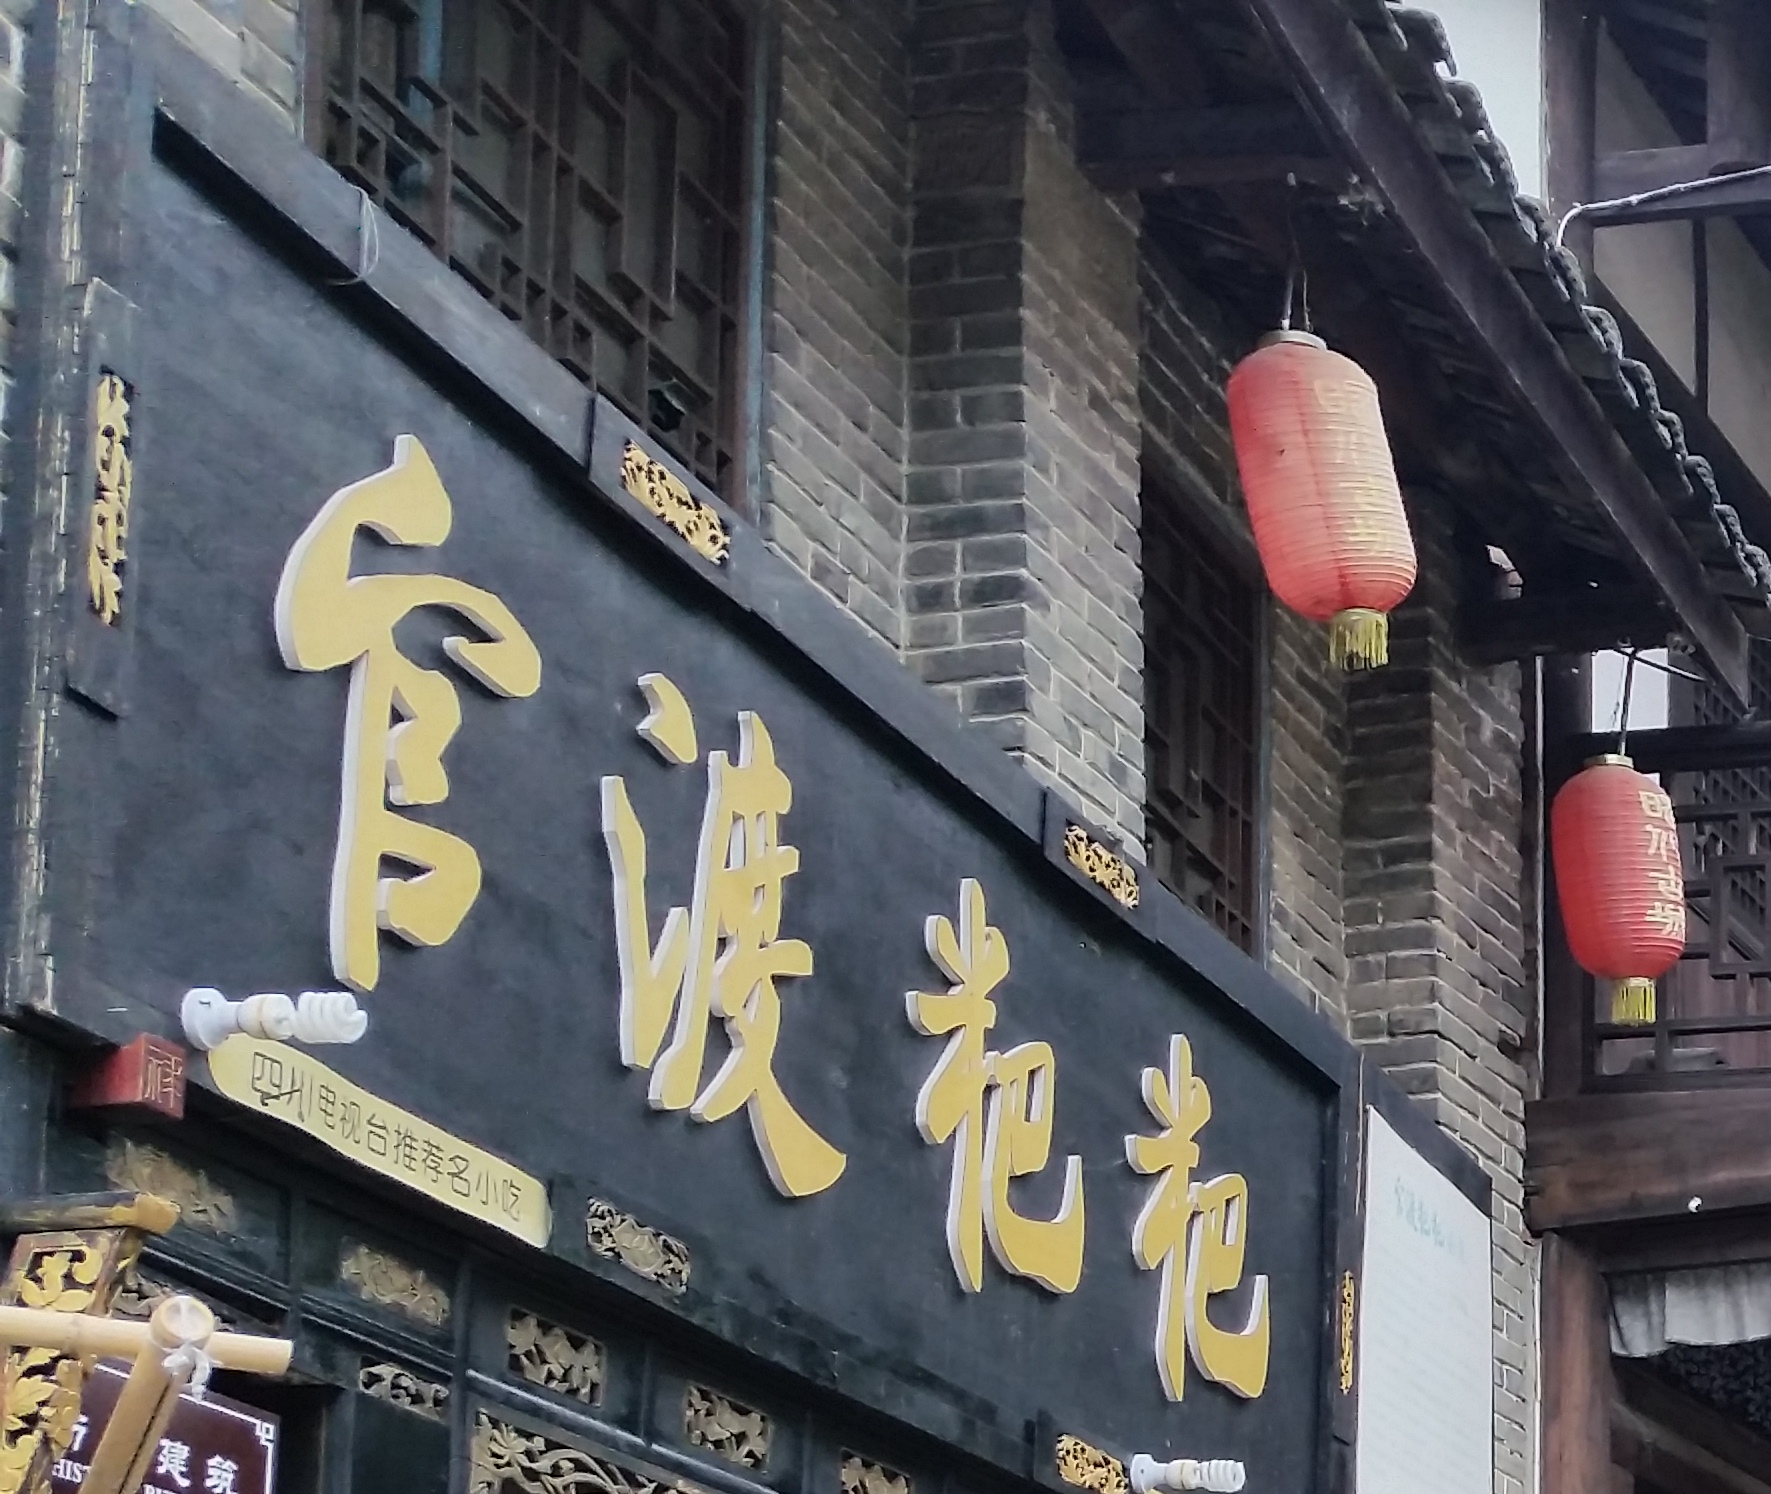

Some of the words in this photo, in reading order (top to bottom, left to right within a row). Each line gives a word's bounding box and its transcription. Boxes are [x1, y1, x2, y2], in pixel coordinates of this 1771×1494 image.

[275, 433, 1272, 1401] 官渡粑粑
[1638, 790, 1685, 940] 昭化古城
[251, 1051, 522, 1222] 四川电视台推荐名小吃
